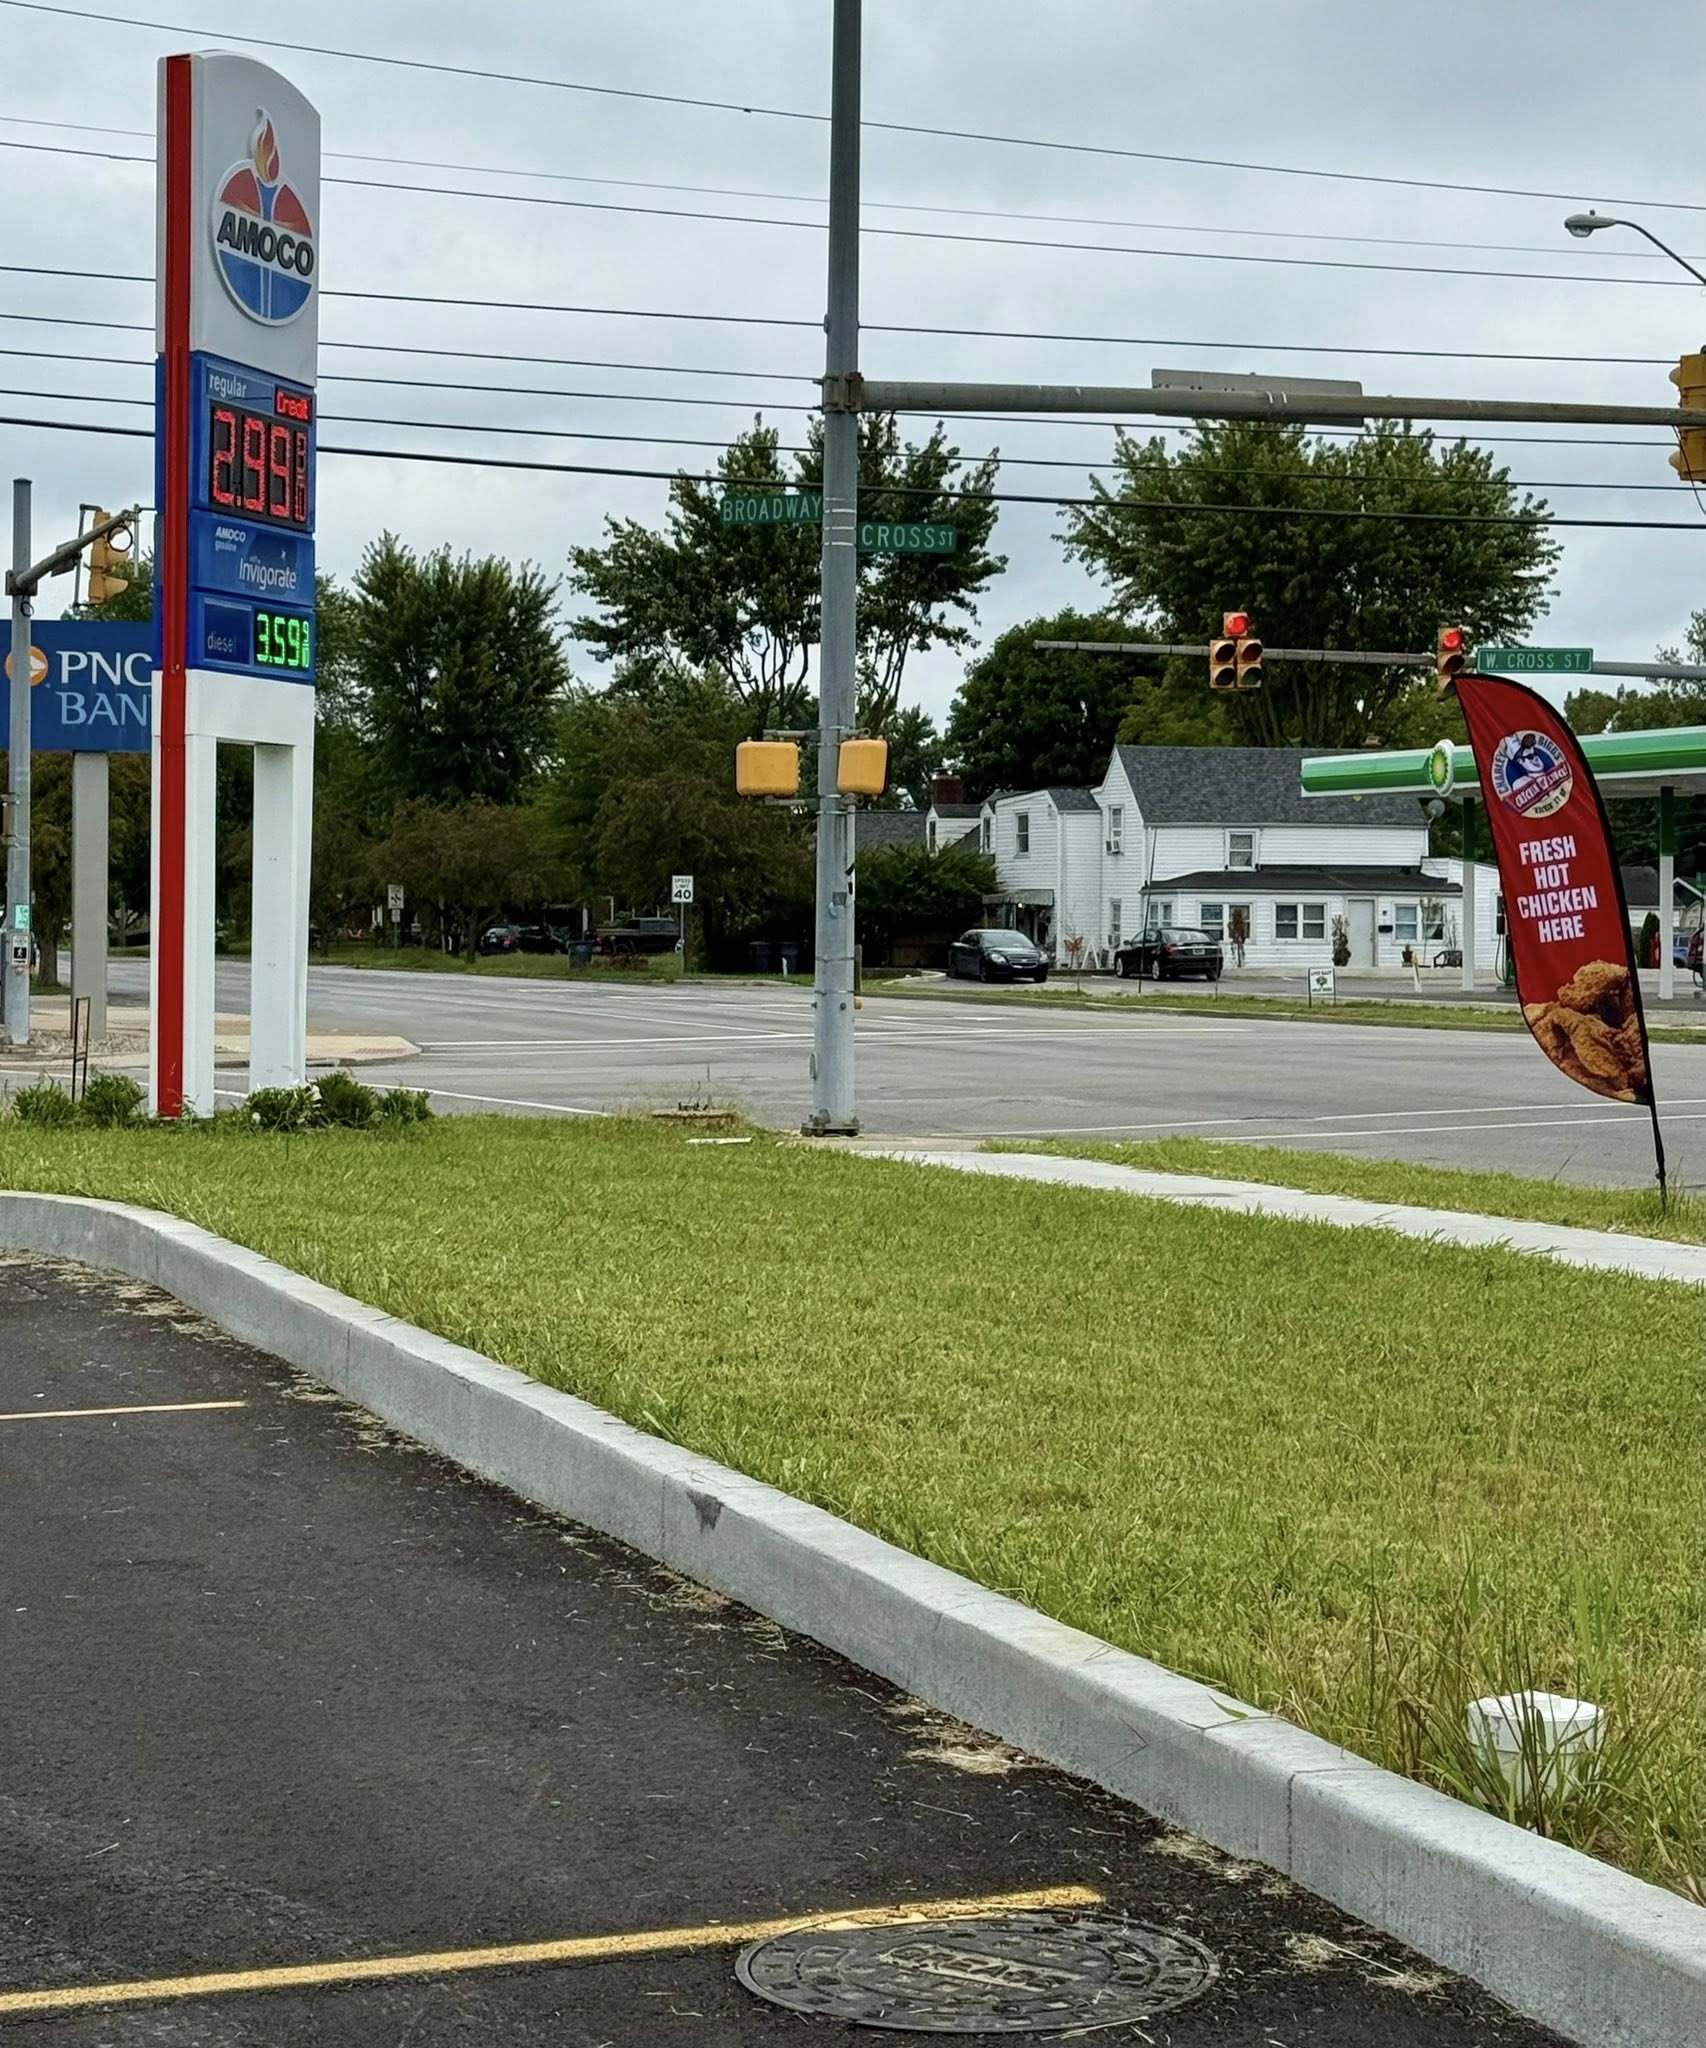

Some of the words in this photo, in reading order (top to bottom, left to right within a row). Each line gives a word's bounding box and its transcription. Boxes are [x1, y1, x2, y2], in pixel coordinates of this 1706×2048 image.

[217, 211, 314, 276] AMOCO
[209, 373, 247, 398] regular
[722, 495, 821, 522] BROADWAY
[215, 526, 246, 543] AMOCO
[861, 523, 935, 549] CROSS
[938, 531, 954, 547] ST
[239, 557, 297, 591] Invigorate
[207, 631, 237, 653] diesel
[55, 650, 153, 687] PNC
[1485, 653, 1499, 669] W.
[1507, 653, 1555, 669] CROSS
[55, 691, 153, 727] BAN
[1518, 835, 1577, 866] FRESH
[1533, 862, 1570, 890] HOT
[674, 889, 692, 900] 40
[1516, 885, 1598, 919] CHICKEN
[1537, 915, 1585, 944] HERE
